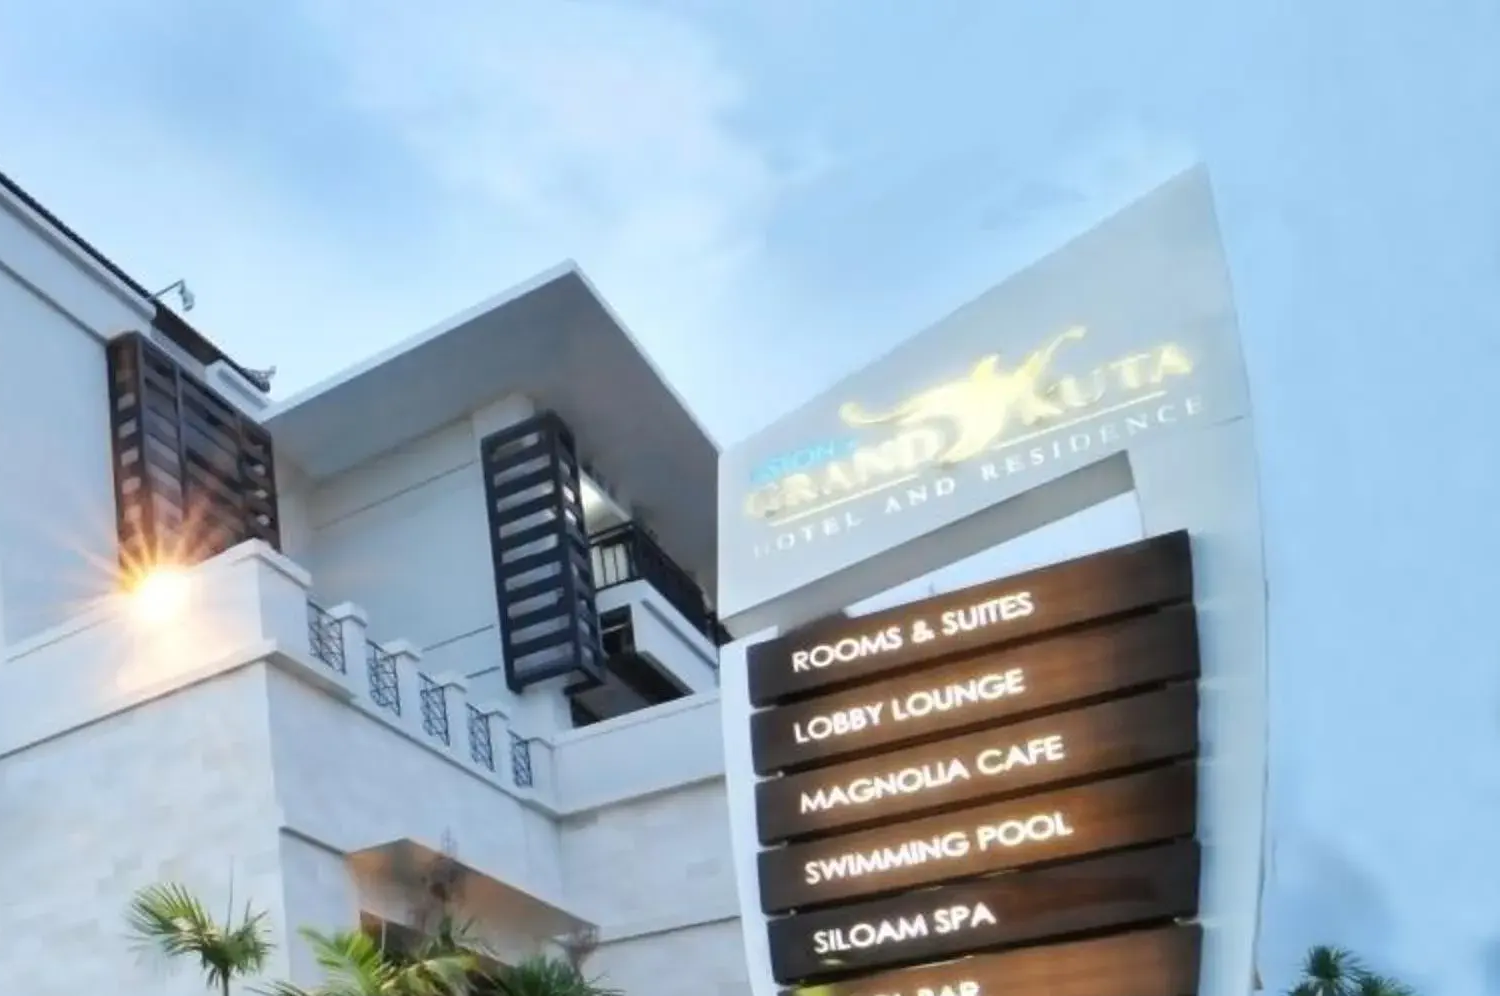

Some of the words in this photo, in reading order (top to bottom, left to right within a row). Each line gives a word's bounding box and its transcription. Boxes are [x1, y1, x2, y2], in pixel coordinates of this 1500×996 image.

[753, 511, 864, 559] HOTEL
[884, 477, 956, 514] AND
[979, 397, 1204, 482] RESIDENCE
[792, 627, 903, 673] ROOMS
[910, 620, 935, 644] &
[942, 592, 1035, 636] SUITES
[793, 702, 884, 744] LOBBY
[892, 668, 1026, 721] LOUNGE
[800, 756, 969, 814] MAGNOLIA
[977, 735, 1066, 776] CAFE
[805, 831, 968, 885] SWIMMING
[977, 811, 1074, 852] POOL
[813, 914, 928, 954] SILOAM
[935, 902, 996, 935] SPA
